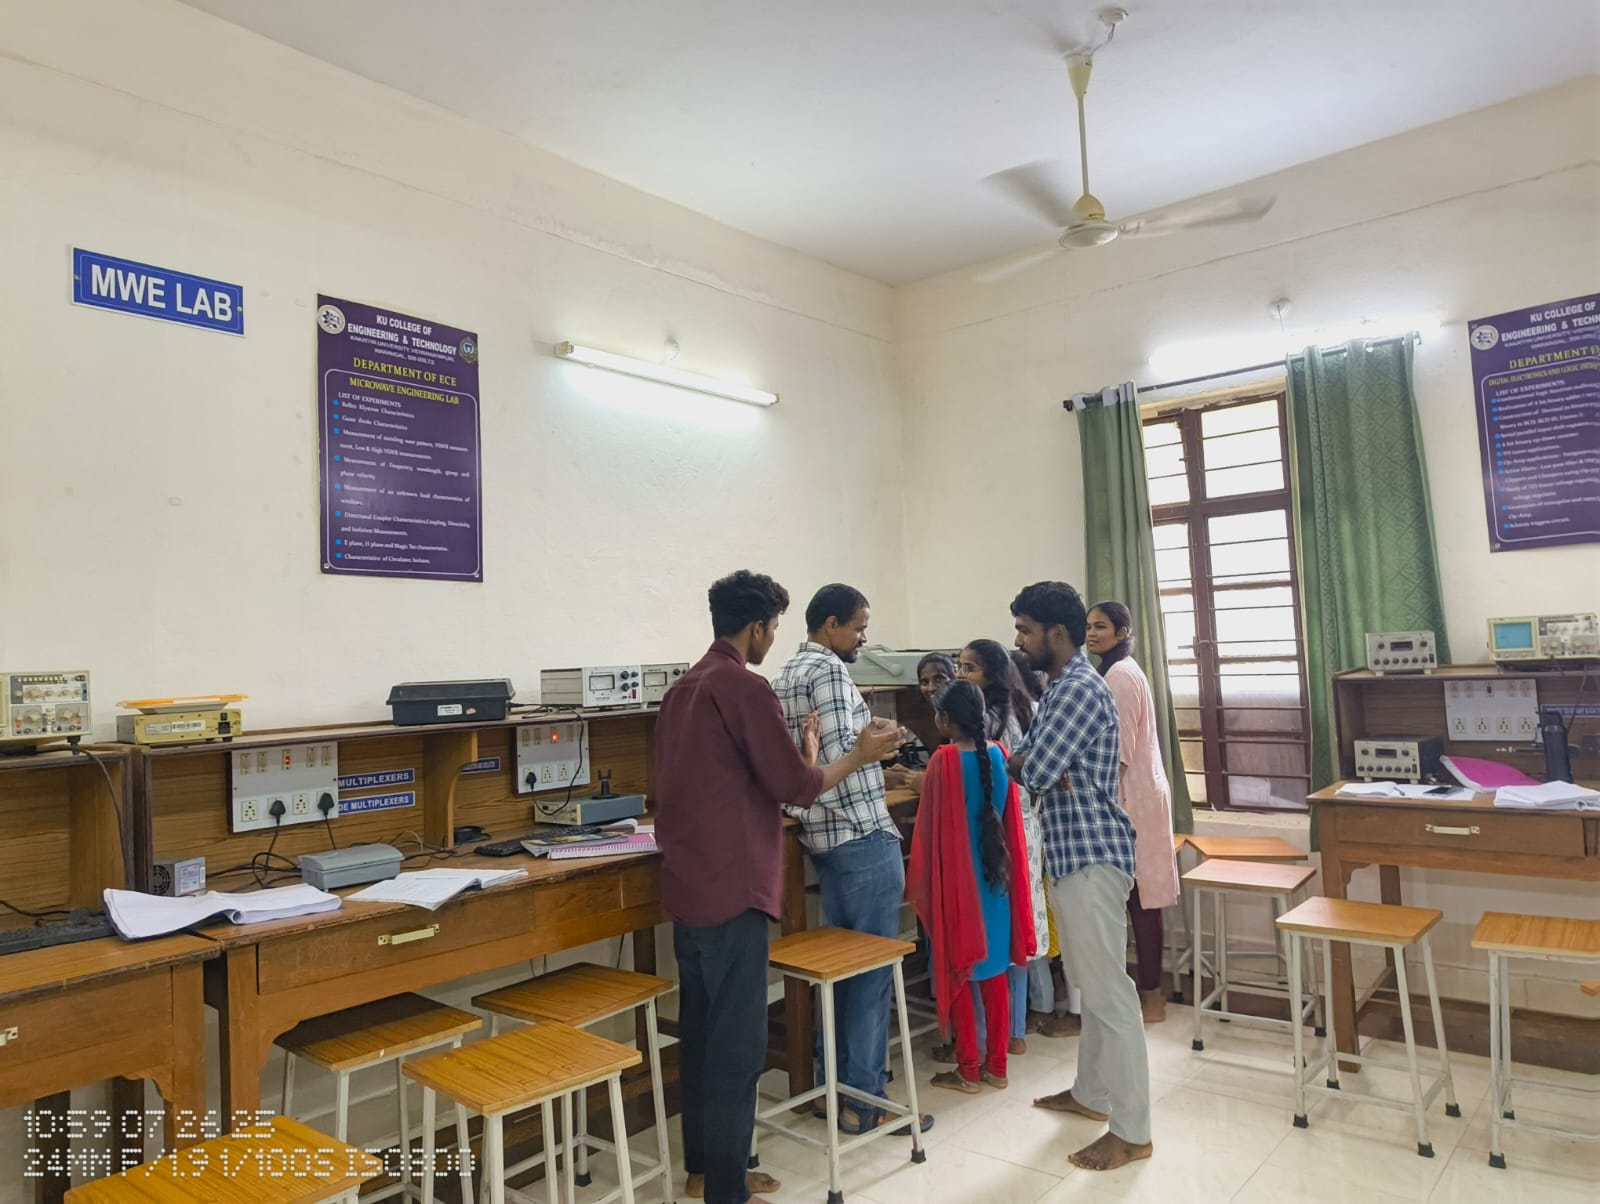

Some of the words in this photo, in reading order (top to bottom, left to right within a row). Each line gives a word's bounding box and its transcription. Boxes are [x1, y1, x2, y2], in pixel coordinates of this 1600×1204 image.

[92, 264, 166, 309] MWE
[176, 283, 233, 322] LAB
[1530, 313, 1542, 323] KU
[1544, 304, 1582, 319] COLLEGE
[1584, 301, 1595, 311] OF
[376, 315, 387, 326] KU
[389, 318, 421, 333] COLLEGE
[422, 326, 432, 336] OF
[1501, 323, 1556, 341] ENGINEERING
[1561, 319, 1568, 329] &
[347, 322, 398, 342] ENGINEERING
[402, 335, 408, 345] &
[411, 337, 456, 355] TECHNOLOGY
[1509, 346, 1588, 368] DEPARTMENT
[353, 357, 421, 379] DEPARTMENT
[423, 372, 437, 383] OF
[439, 375, 456, 386] ECE
[338, 391, 350, 399] LIST
[351, 393, 360, 401] OF
[361, 395, 401, 407] EXPERIMENTS
[349, 377, 396, 393] MICROWAVE
[397, 386, 444, 402] ENGINEERING
[445, 395, 459, 405] LAB
[338, 772, 409, 787] MULTIPLEXERS
[351, 795, 409, 810] MULTIPLEXERS
